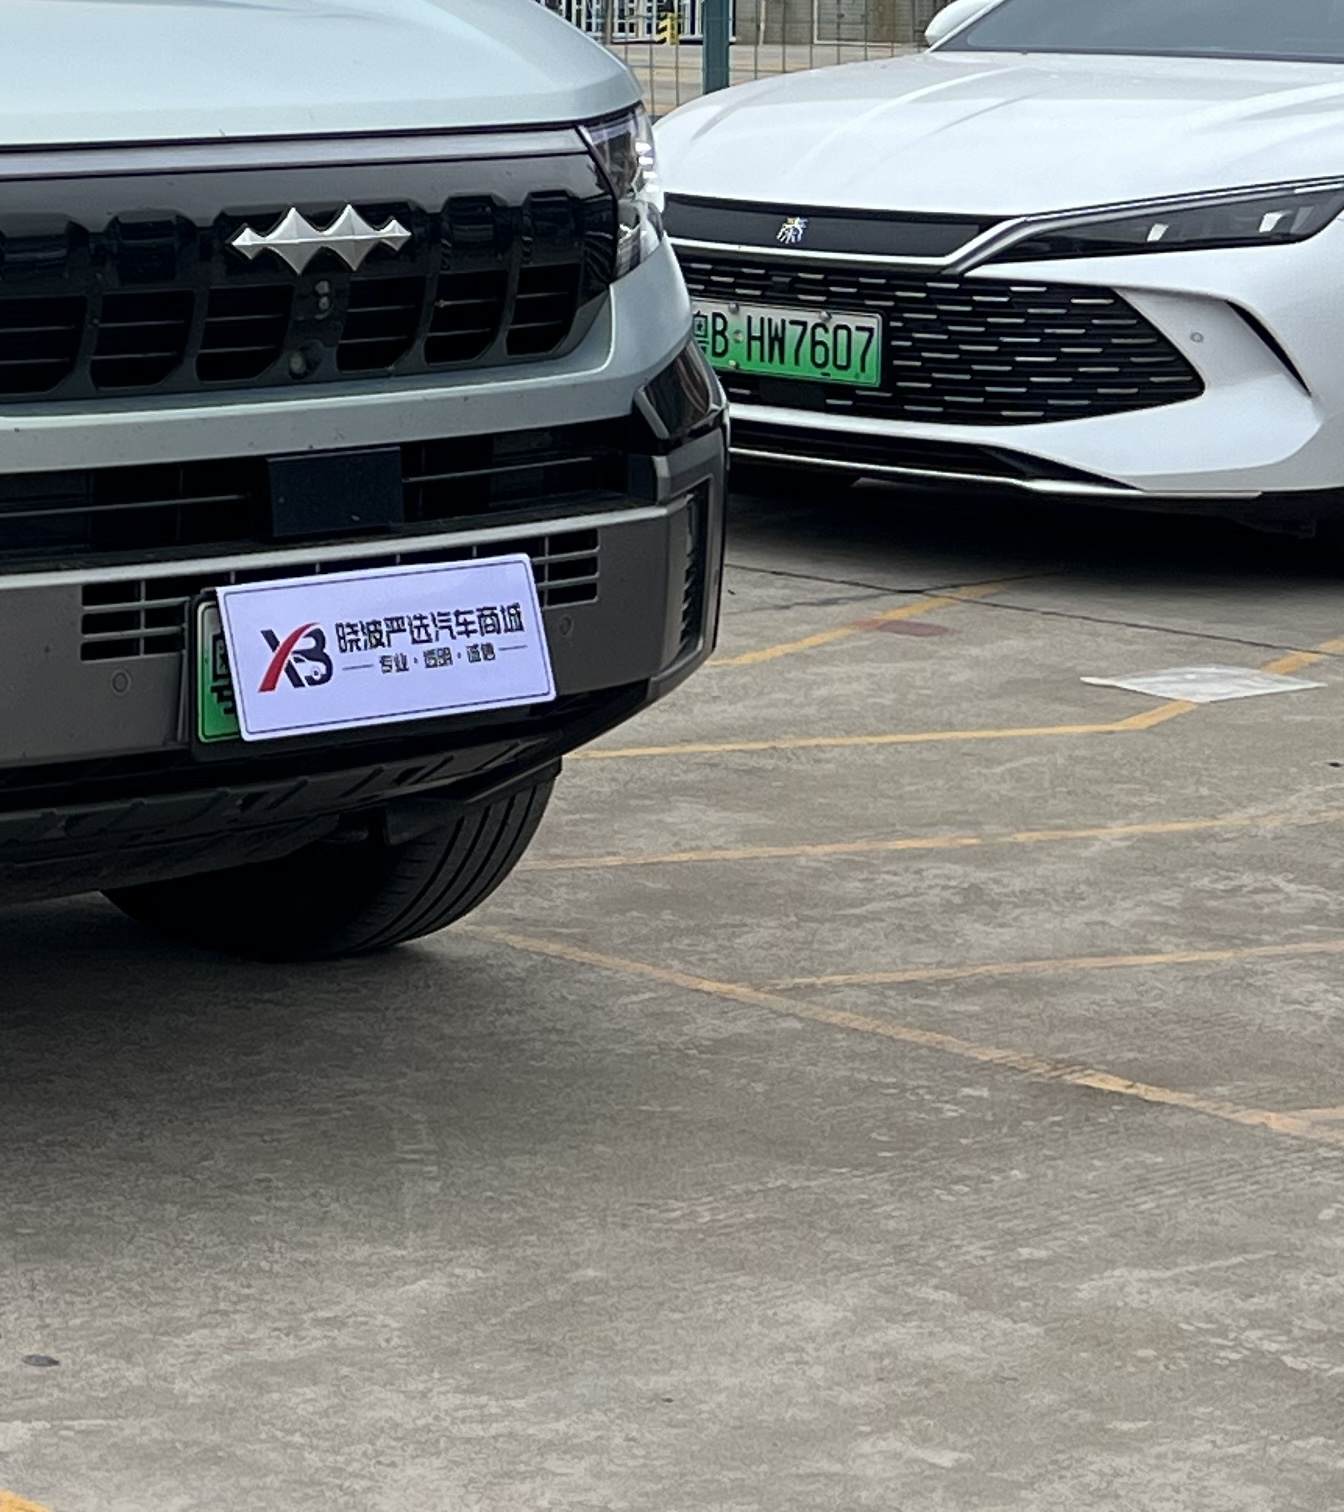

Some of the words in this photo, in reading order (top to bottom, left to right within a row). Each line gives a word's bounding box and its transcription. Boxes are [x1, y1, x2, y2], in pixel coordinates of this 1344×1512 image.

[335, 602, 525, 654] 晓波严选汽车商城
